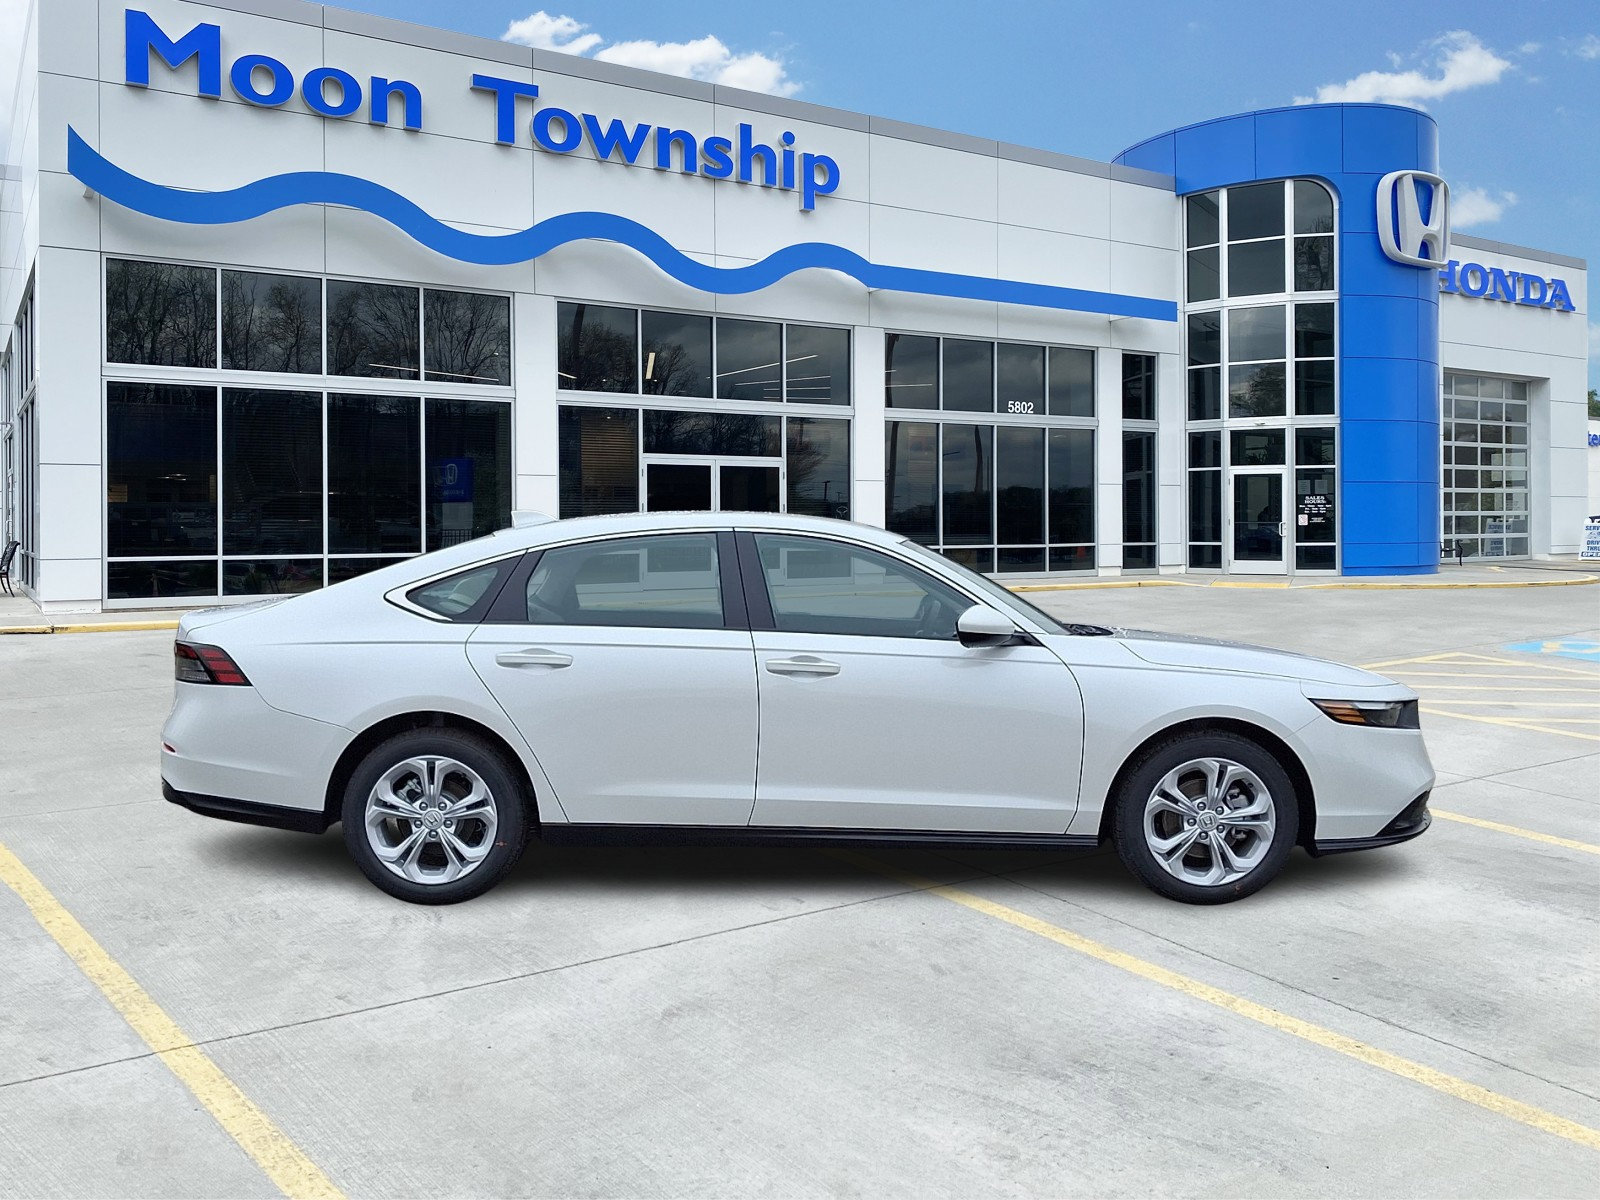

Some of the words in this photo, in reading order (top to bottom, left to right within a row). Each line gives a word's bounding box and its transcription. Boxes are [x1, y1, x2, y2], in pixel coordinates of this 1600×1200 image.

[125, 8, 422, 131] Moon
[469, 73, 840, 213] Township
[1007, 400, 1034, 414] 5802
